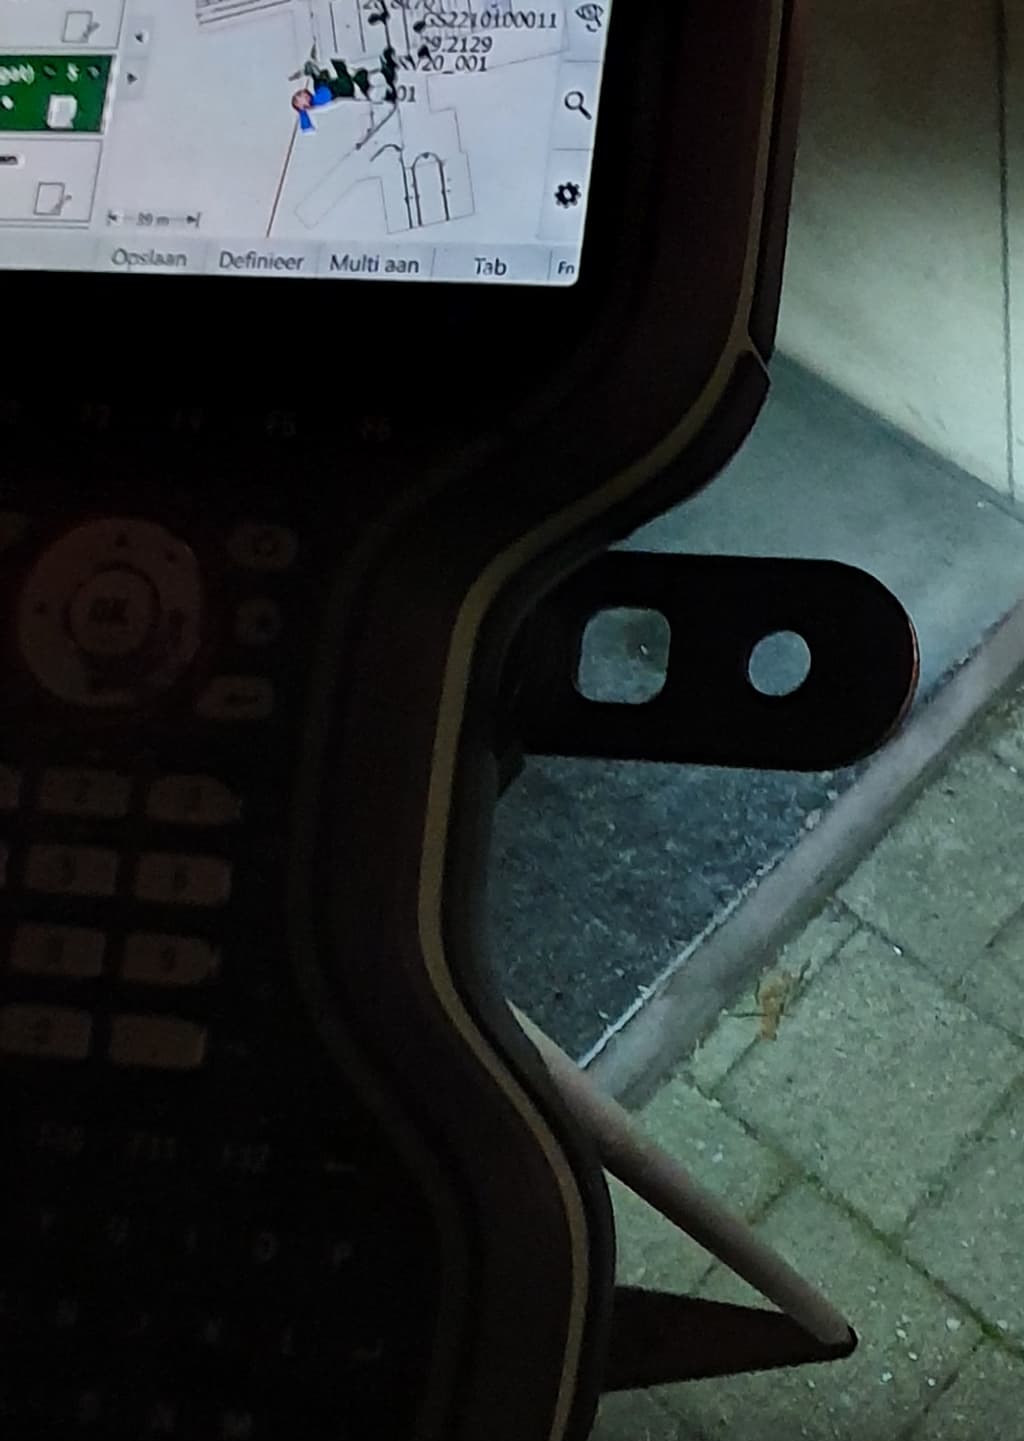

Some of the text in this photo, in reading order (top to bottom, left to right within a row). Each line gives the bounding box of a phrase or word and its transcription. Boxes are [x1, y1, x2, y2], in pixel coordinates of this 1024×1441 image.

[111, 248, 576, 276] Opslaan Definieer Multi aan Tab Fn
